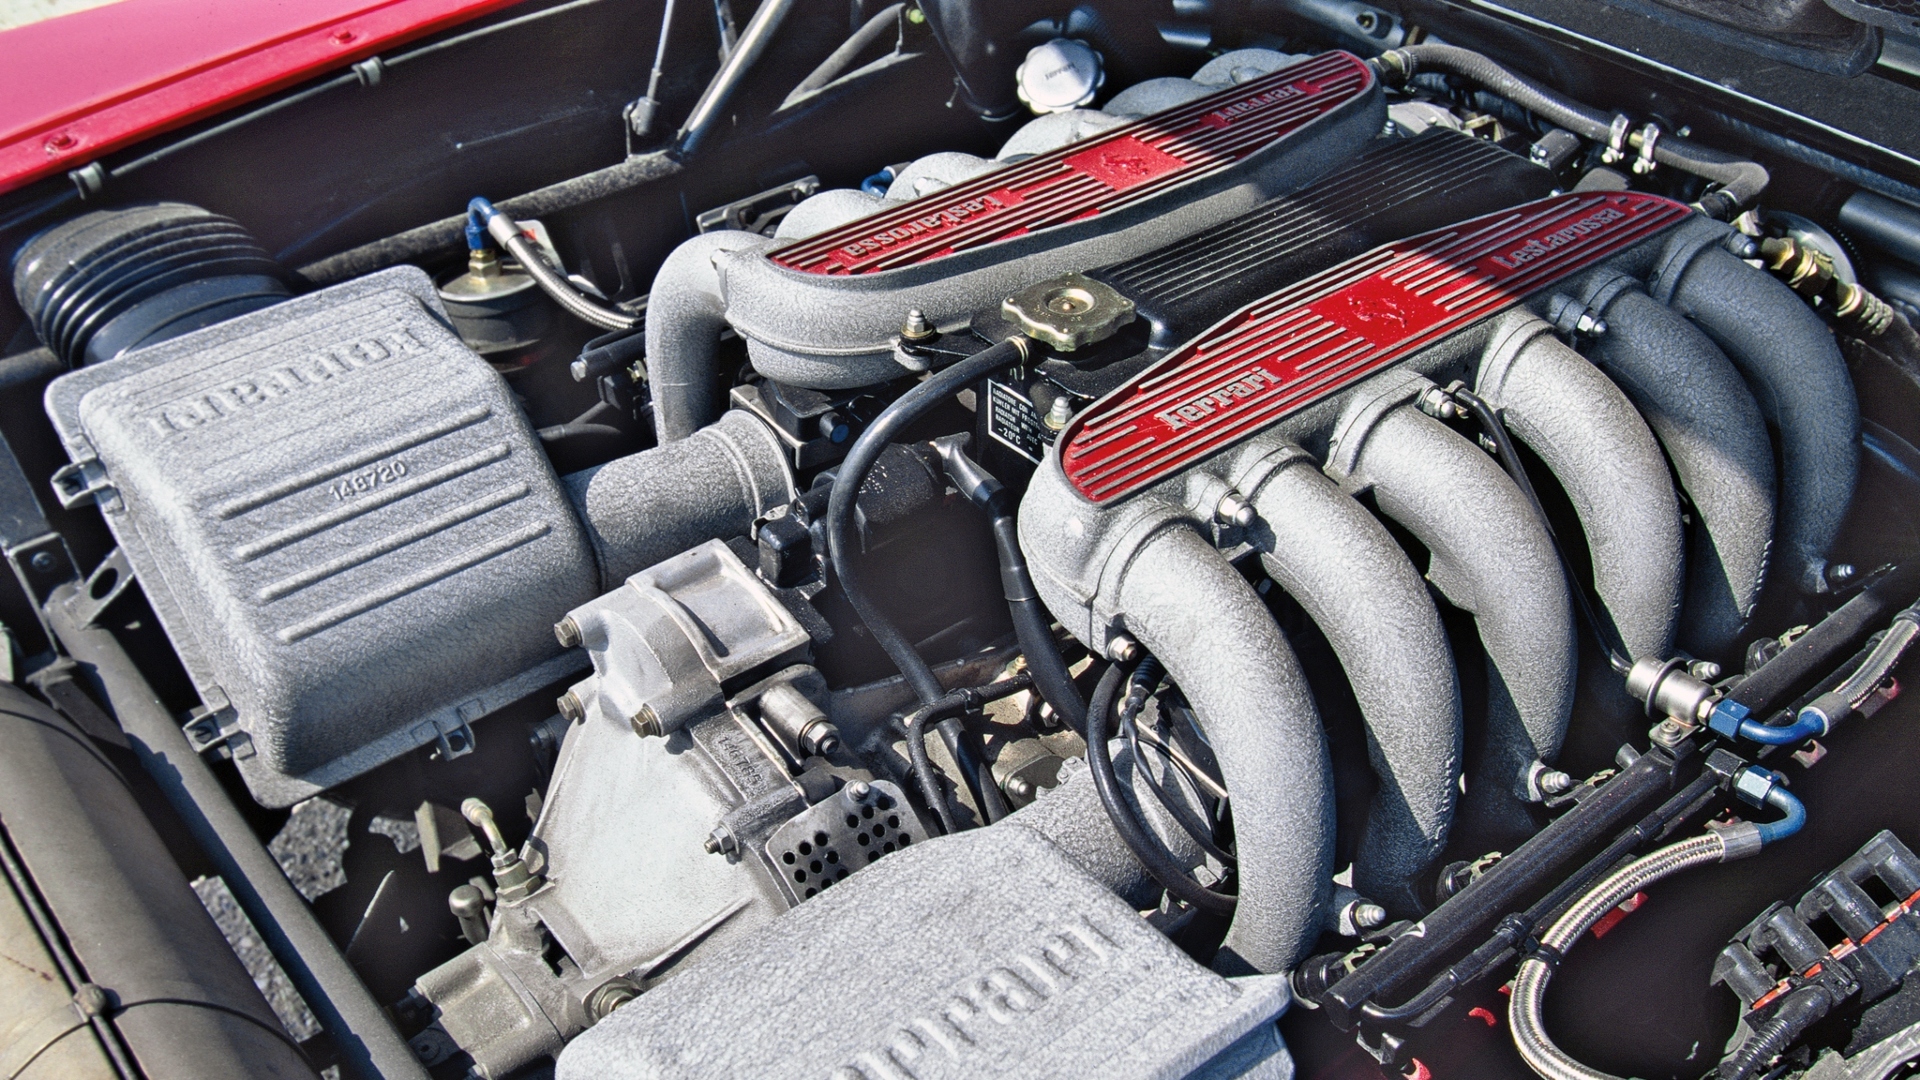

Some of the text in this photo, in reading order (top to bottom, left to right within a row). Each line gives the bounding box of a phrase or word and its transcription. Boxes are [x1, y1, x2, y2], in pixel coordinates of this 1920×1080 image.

[1212, 84, 1306, 121] Ferrari
[1154, 366, 1282, 431] Ferrari
[328, 460, 408, 500] 148720
